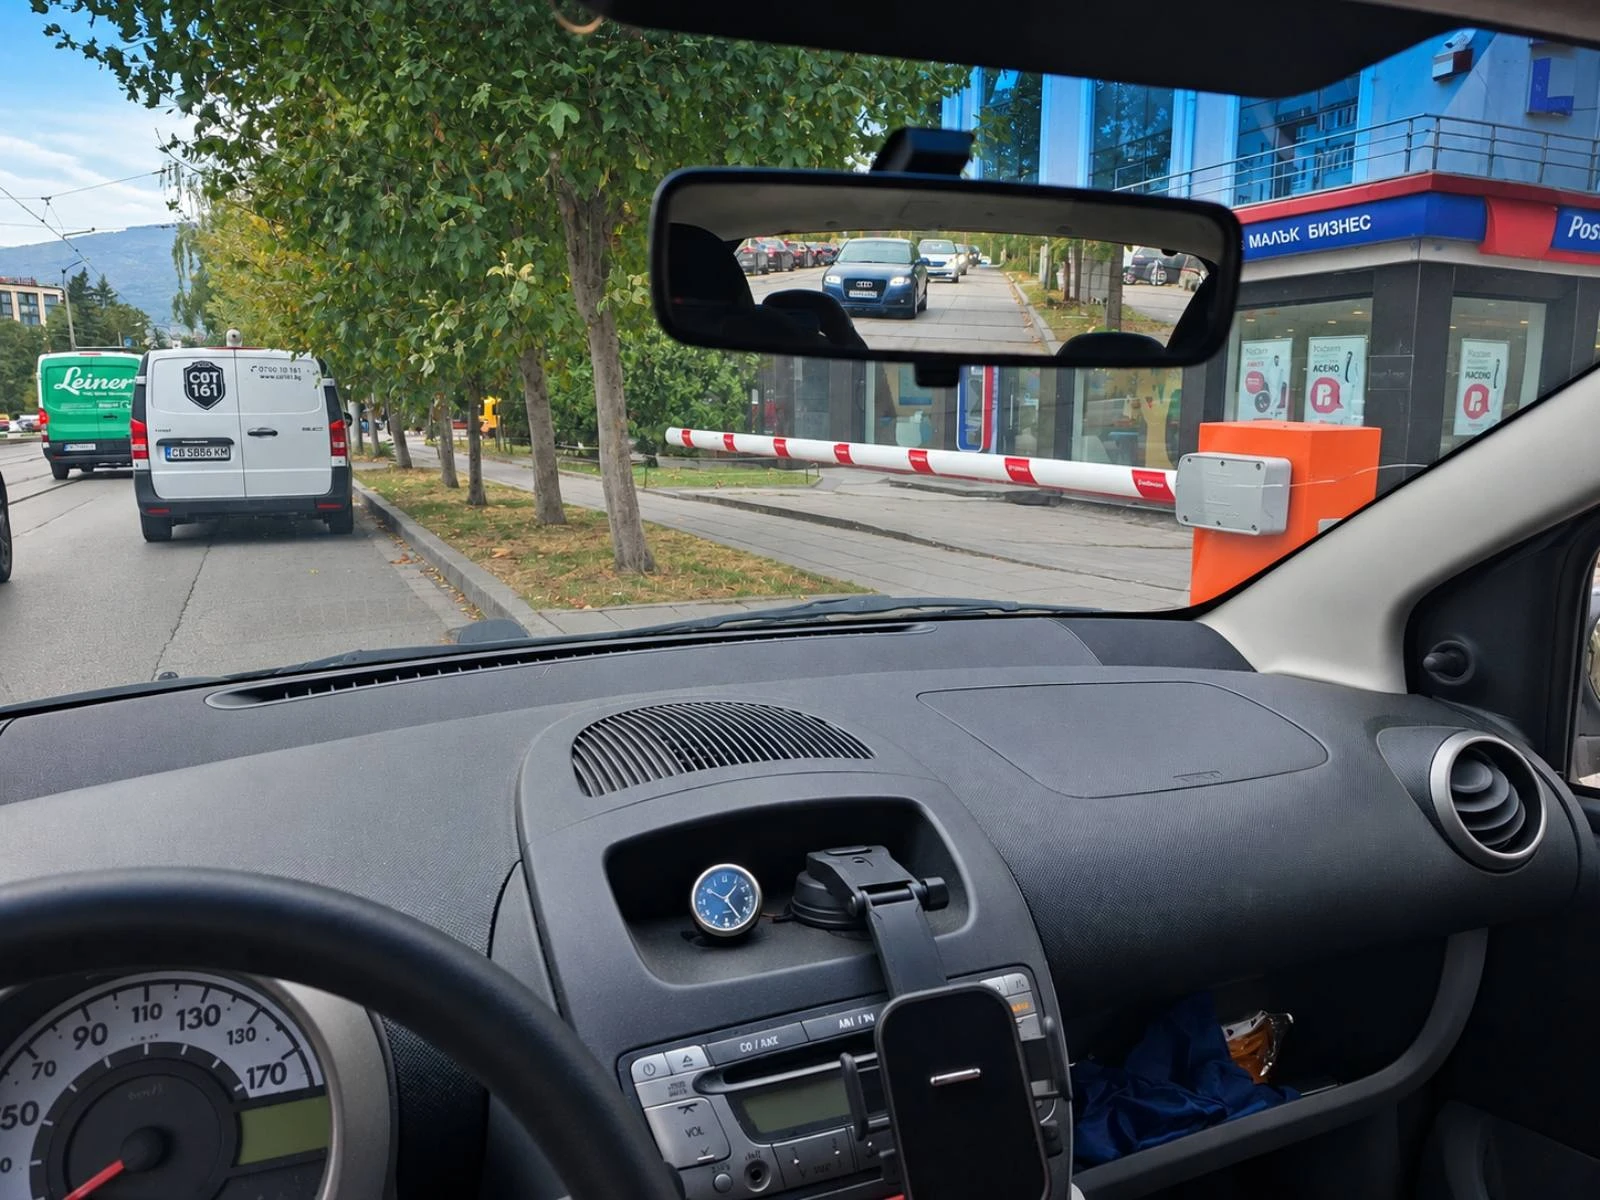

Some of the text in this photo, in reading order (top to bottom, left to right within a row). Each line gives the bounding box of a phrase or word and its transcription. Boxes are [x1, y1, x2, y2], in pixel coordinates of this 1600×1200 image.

[1249, 214, 1371, 249] МАЛЪК БИЗНЕС
[1568, 215, 1600, 240] Pos
[54, 367, 134, 395] Leiner
[191, 384, 218, 397] 161
[132, 1003, 162, 1023] 110
[176, 1004, 221, 1031] 130
[73, 1022, 108, 1050] 90
[226, 1027, 257, 1045] 130
[31, 1060, 57, 1080] 70
[246, 1061, 288, 1089] 170
[685, 1126, 704, 1138] VOL
